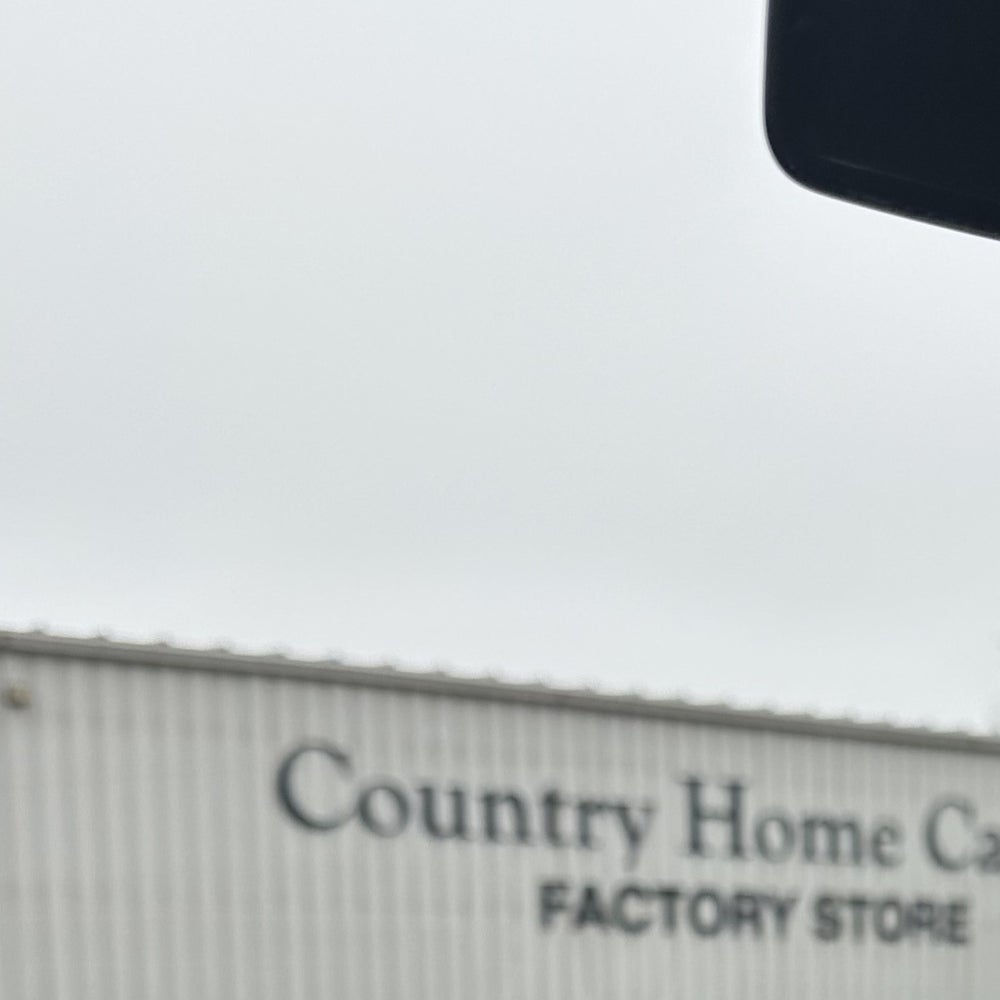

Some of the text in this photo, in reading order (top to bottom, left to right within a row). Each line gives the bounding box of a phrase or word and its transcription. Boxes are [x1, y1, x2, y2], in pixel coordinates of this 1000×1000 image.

[275, 739, 654, 868] Country
[681, 775, 903, 868] Home
[539, 880, 971, 944] FACTORY STORE
